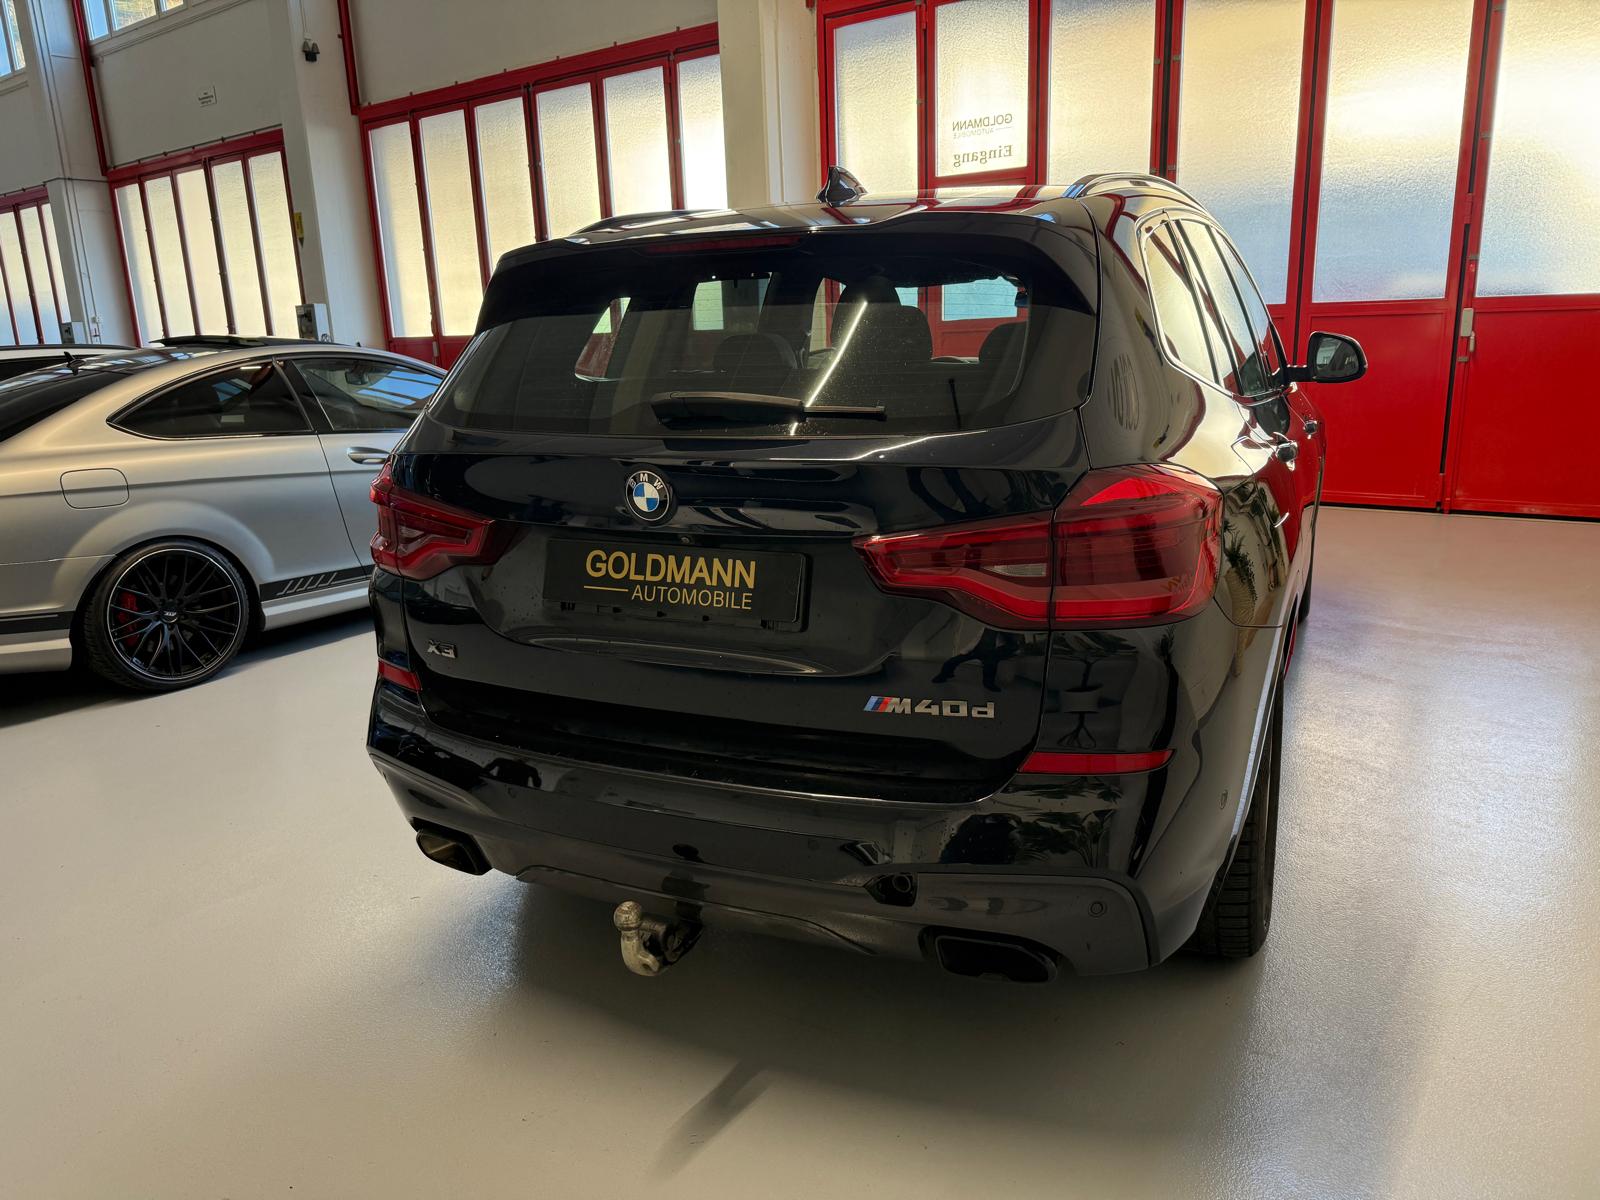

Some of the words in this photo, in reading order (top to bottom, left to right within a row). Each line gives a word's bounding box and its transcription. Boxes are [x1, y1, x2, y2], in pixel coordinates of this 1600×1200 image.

[629, 473, 663, 490] BMW
[585, 549, 756, 589] GOLDMANN
[631, 584, 753, 610] AUTOMOBILE
[427, 640, 456, 659] X3
